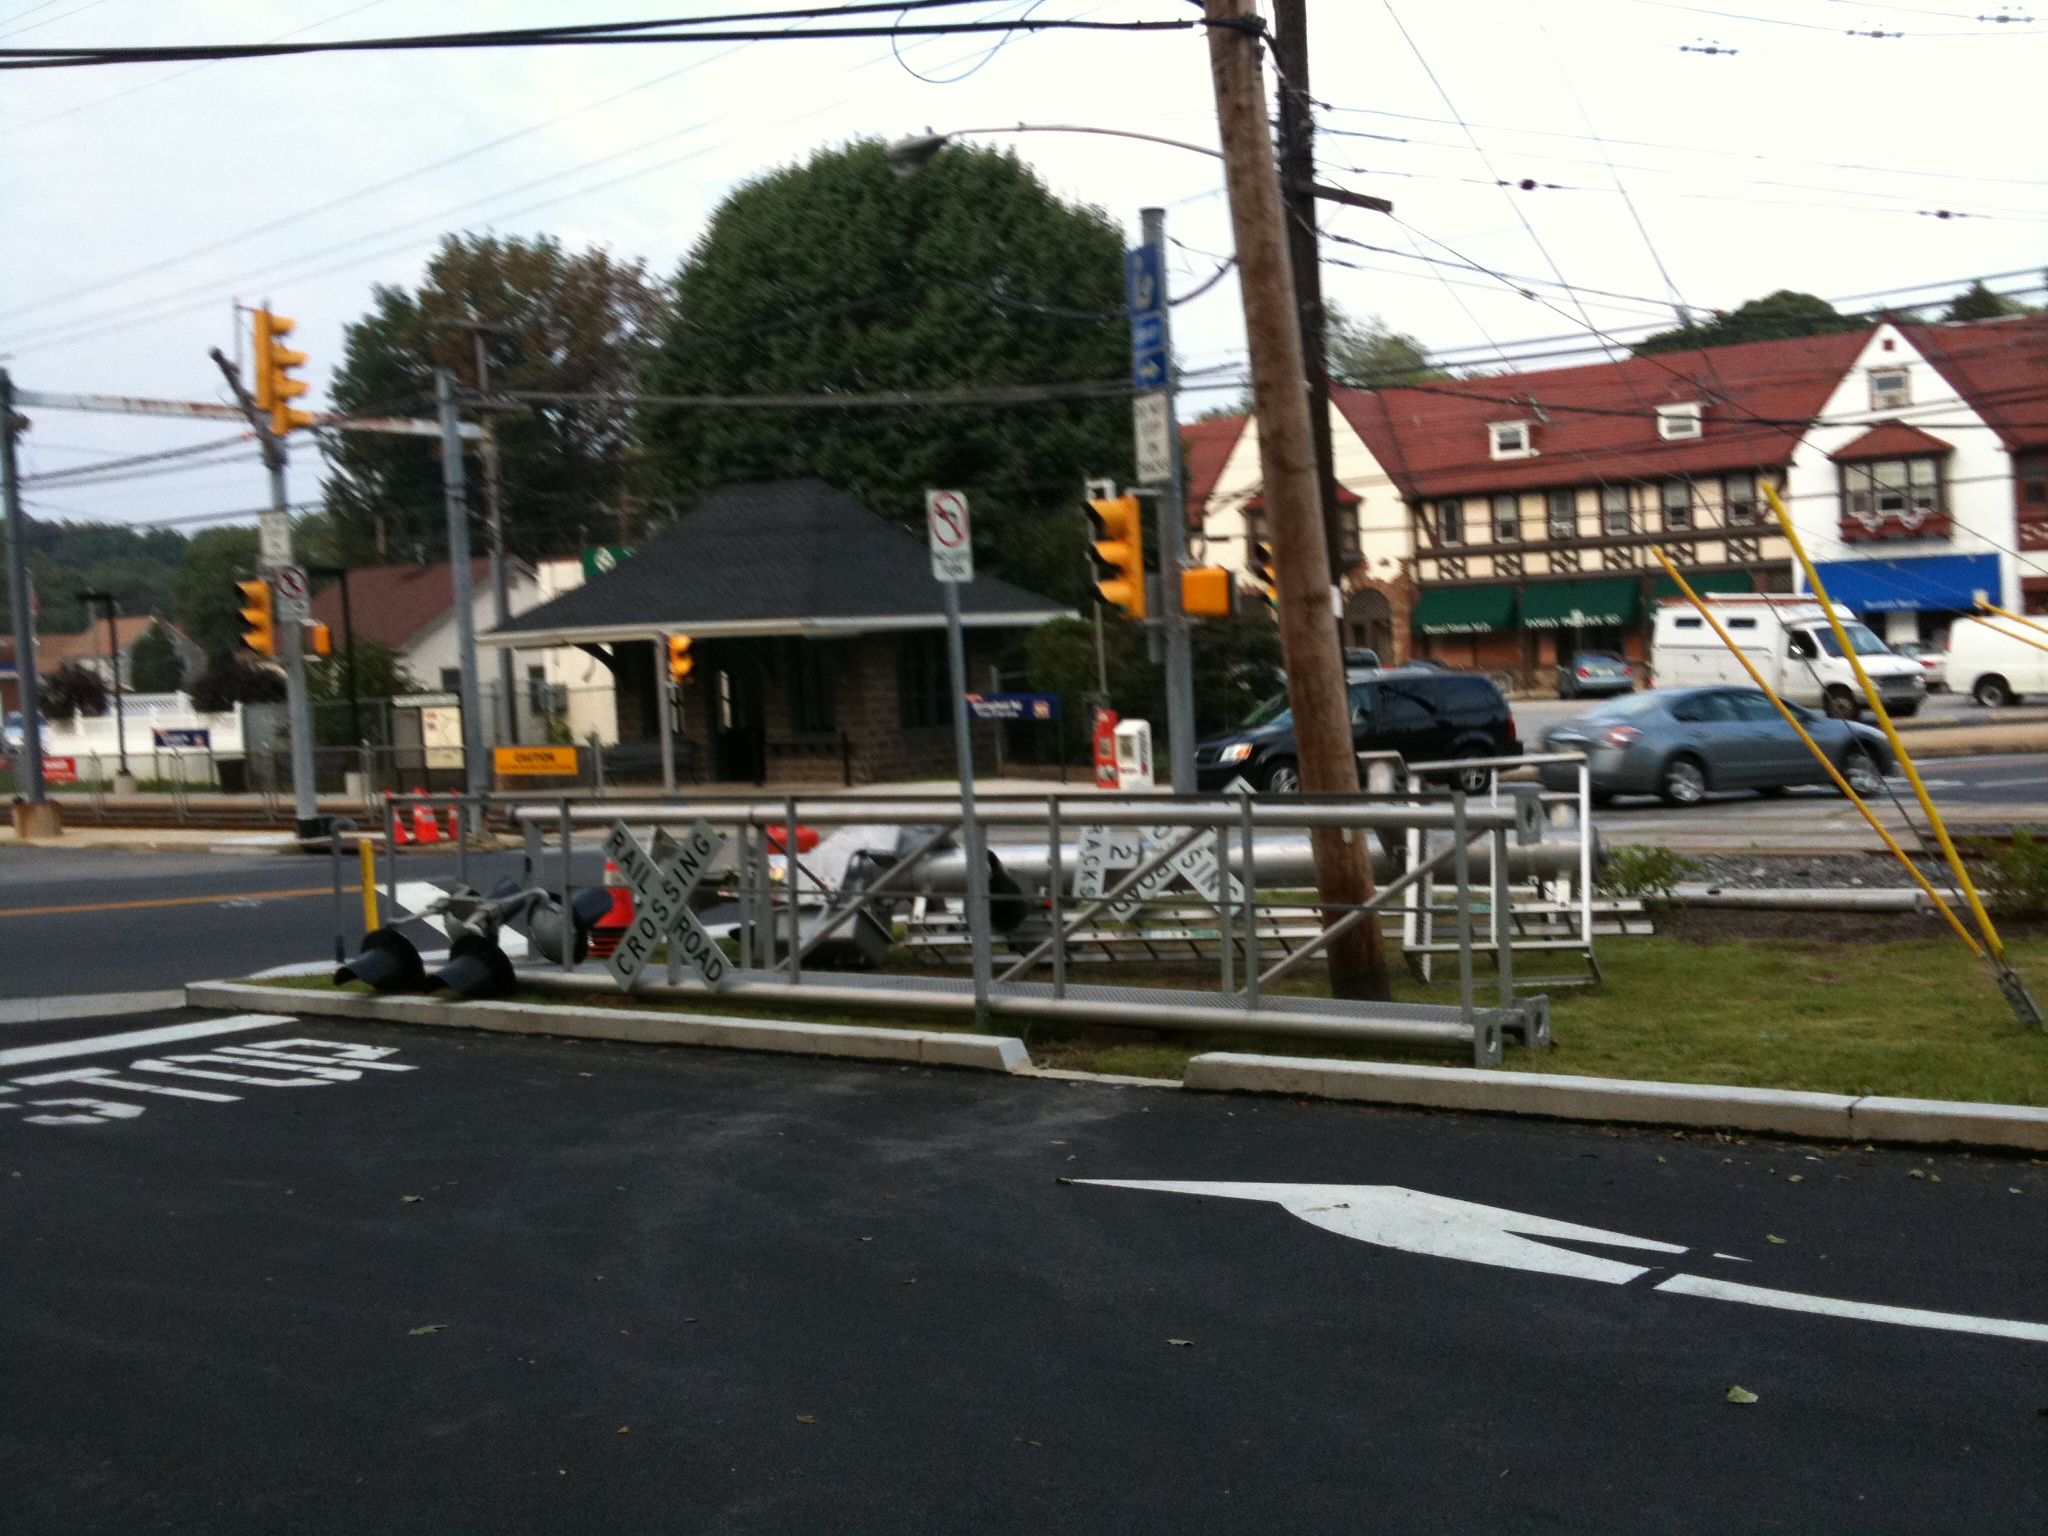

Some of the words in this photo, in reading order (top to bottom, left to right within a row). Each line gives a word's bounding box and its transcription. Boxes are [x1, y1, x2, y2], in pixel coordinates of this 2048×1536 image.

[607, 830, 652, 896] RAIL
[673, 915, 723, 982] ROAD
[615, 833, 712, 977] CROSSING
[1110, 844, 1133, 861] 2
